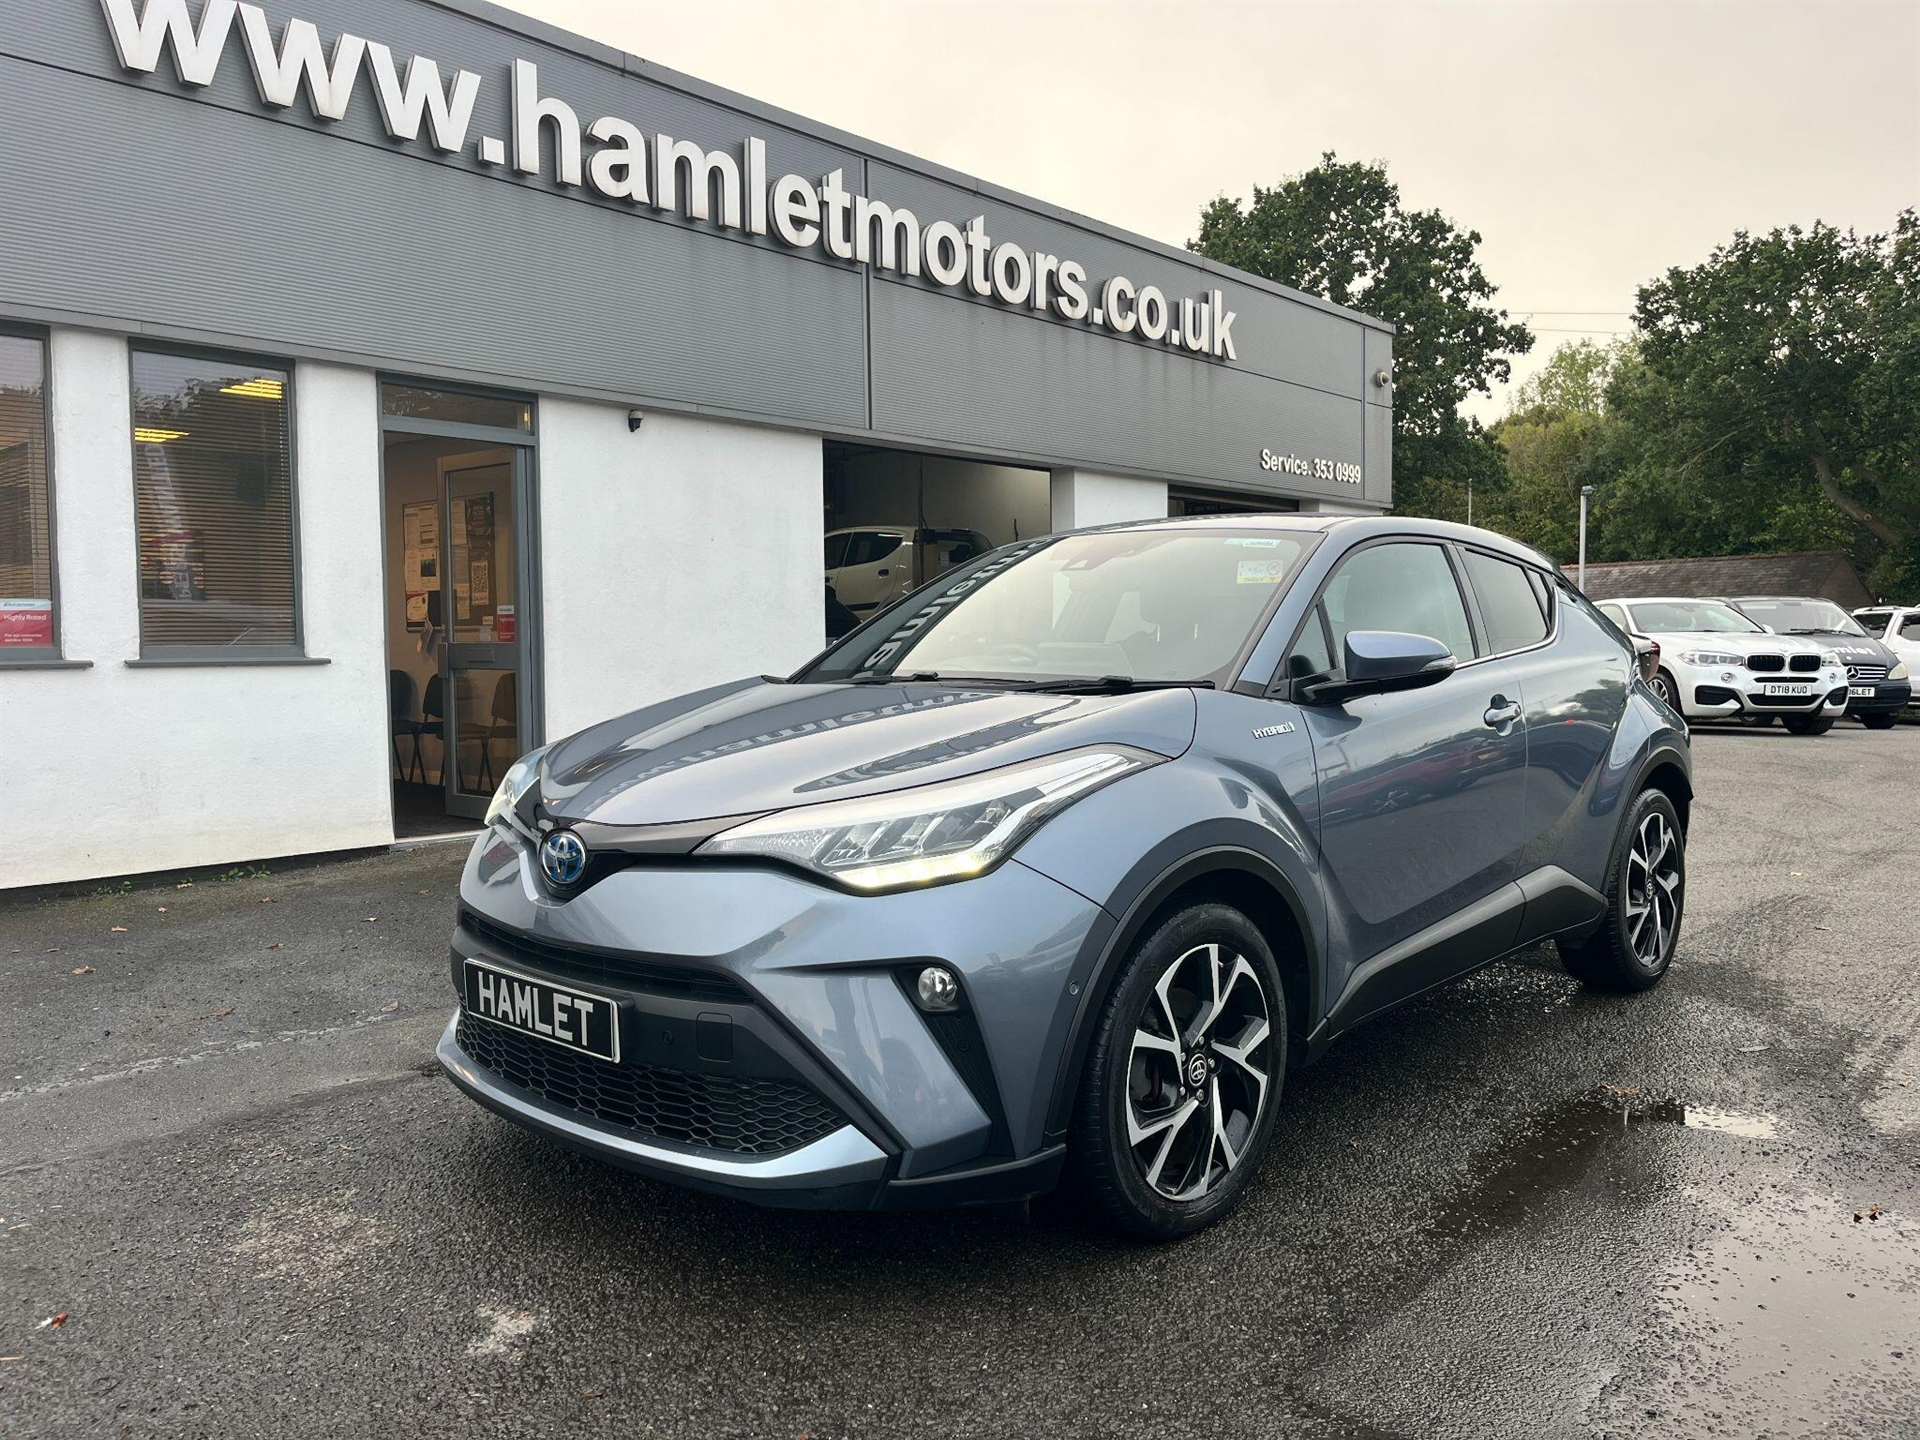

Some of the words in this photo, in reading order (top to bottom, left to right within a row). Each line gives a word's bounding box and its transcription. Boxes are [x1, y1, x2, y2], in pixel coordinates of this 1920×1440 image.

[102, 0, 1237, 361] www.hamletmotors.co.uk
[1261, 448, 1312, 476] Service.
[1313, 458, 1334, 480] 353
[1335, 462, 1361, 484] 0999
[1770, 686, 1790, 694] DT18
[1791, 686, 1808, 694] KUO
[1251, 722, 1293, 739] HYBRID
[478, 971, 594, 1047] HAMLET
